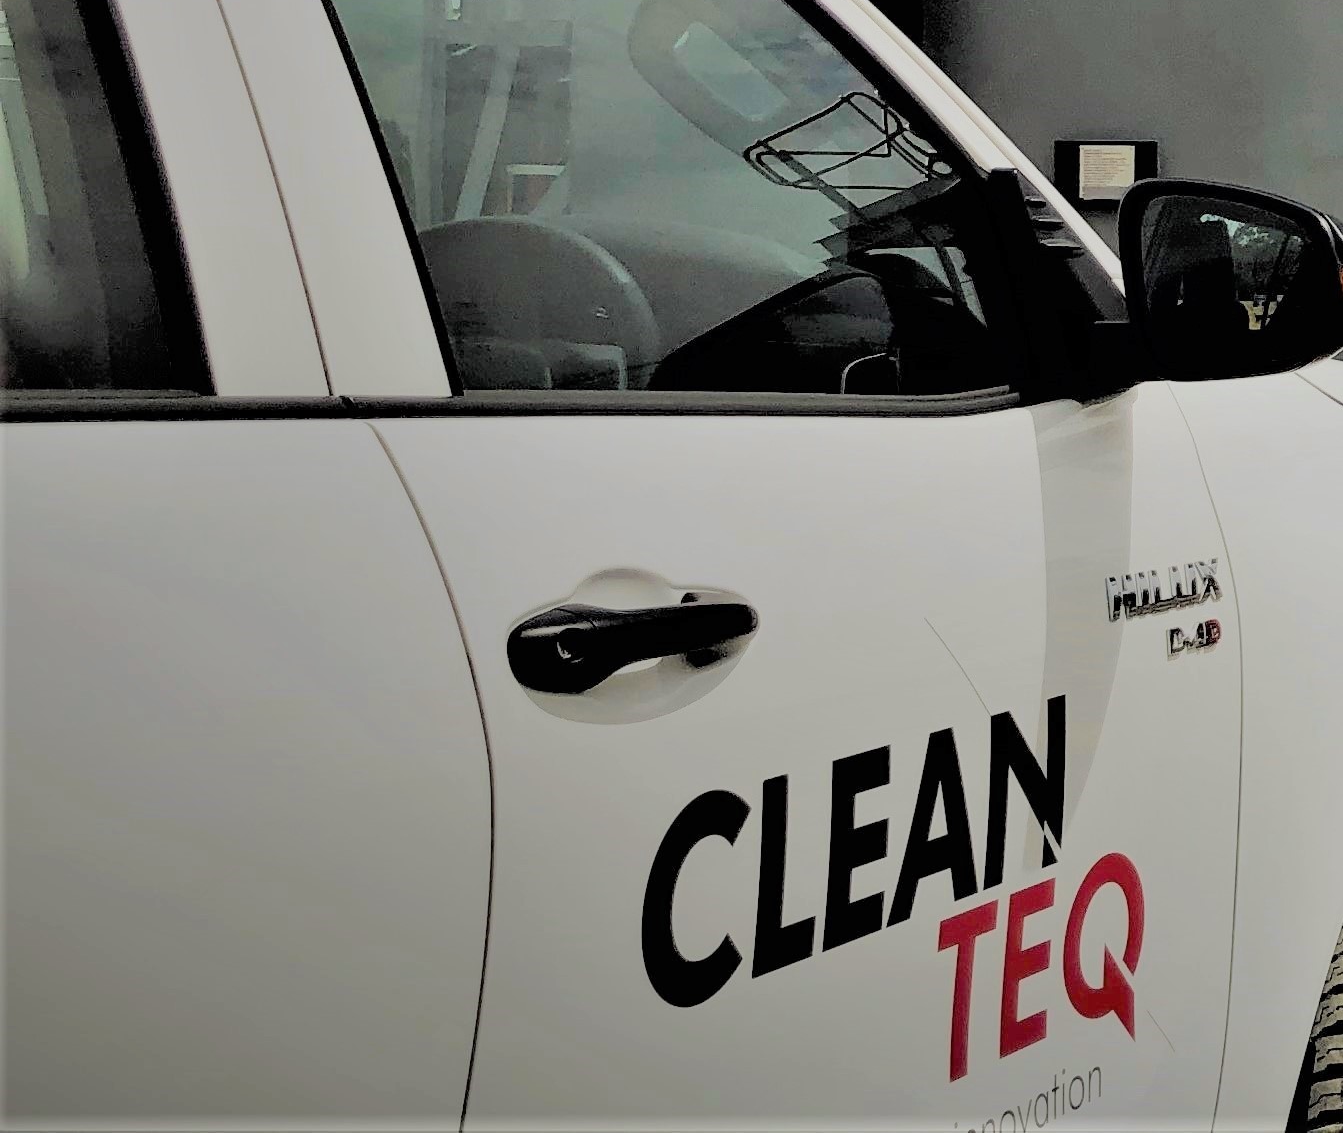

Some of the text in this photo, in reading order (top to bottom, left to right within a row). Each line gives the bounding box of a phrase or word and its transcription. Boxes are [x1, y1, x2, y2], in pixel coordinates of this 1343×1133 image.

[1105, 558, 1222, 622] HILUX
[641, 694, 1067, 1008] CLEAN
[937, 852, 1145, 1084] TEQ
[954, 1066, 1102, 1133] ovation
